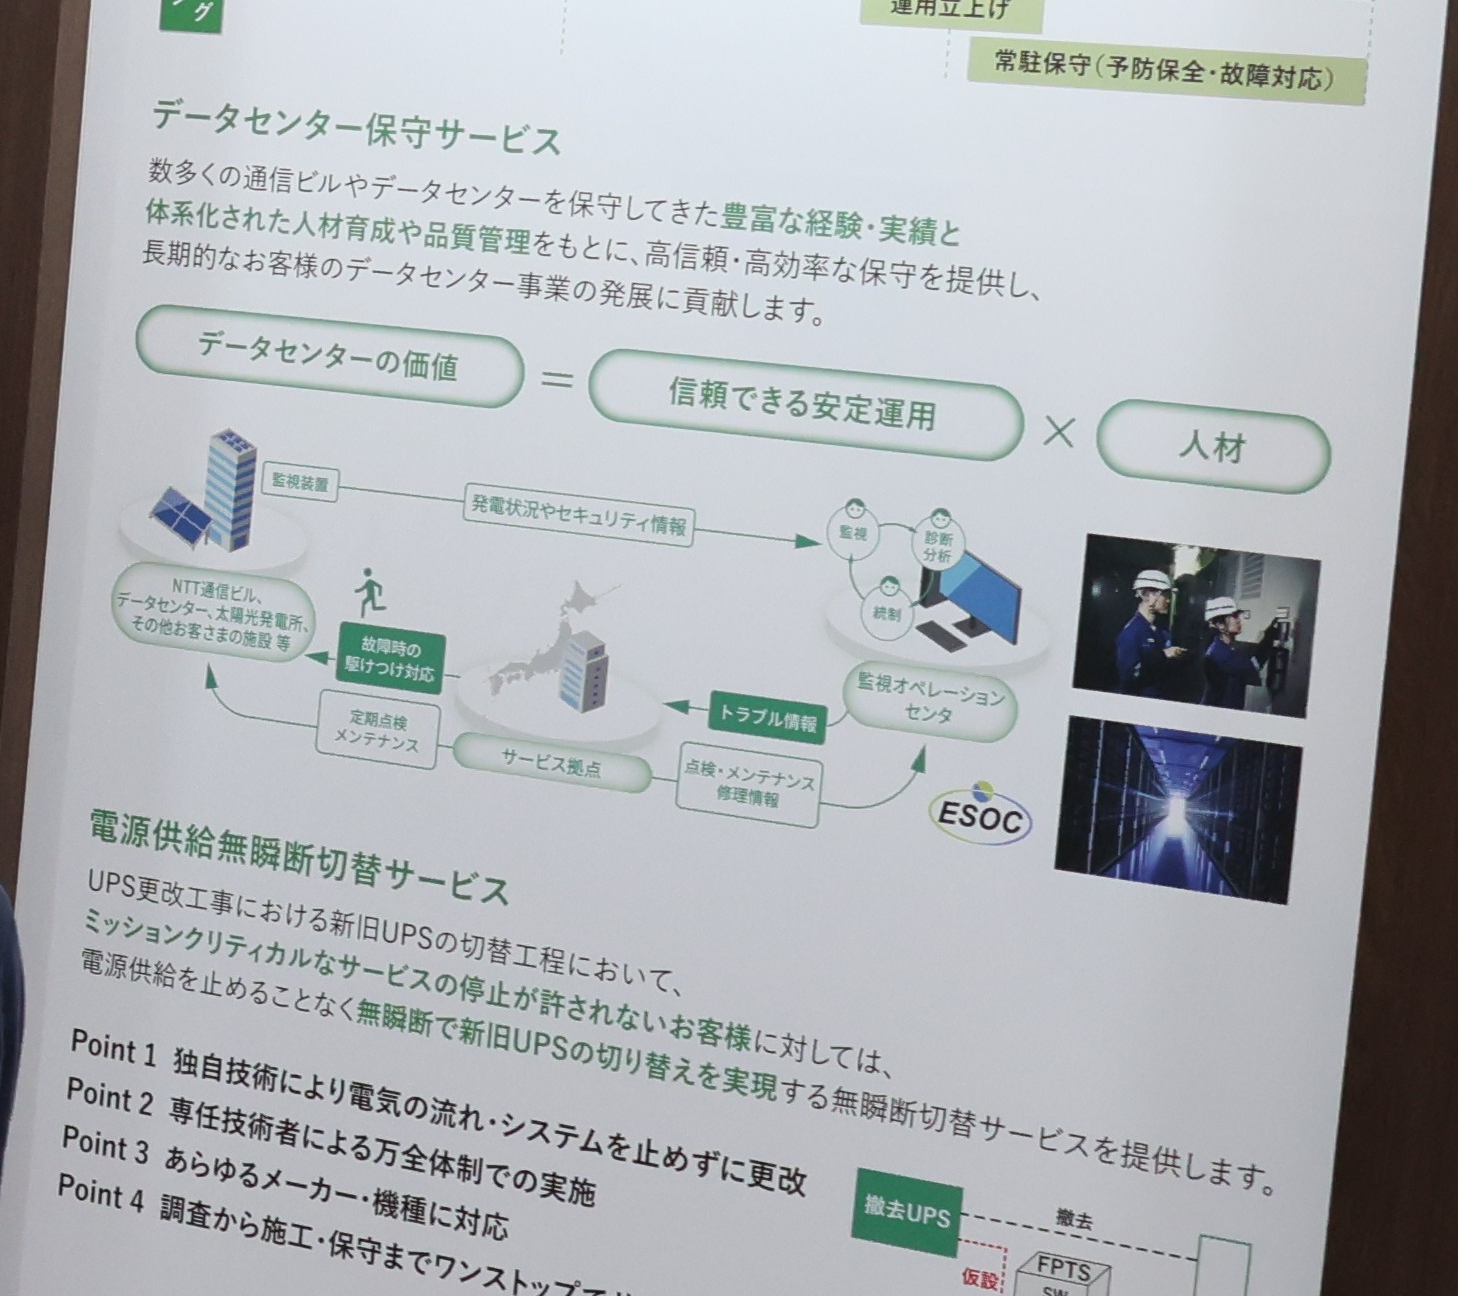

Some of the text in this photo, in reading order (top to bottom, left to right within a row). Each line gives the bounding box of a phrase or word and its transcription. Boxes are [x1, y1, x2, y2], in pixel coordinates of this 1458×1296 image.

[151, 99, 563, 159] データセンター保守サービス
[147, 156, 962, 249] 数多くの通信ビルやデータセンターを保守してきた豊富な経験・実績と
[144, 197, 1041, 303] 体系化された人材育成や品質管理をもとに、高信頼・高効率な保守を提供し、
[141, 238, 825, 328] 長期的なお客様のデータセンター事業の発展に貢献します。
[198, 329, 460, 383] データセンターの価値
[668, 374, 938, 433] 信頼できる安定運用
[1179, 428, 1248, 465] 人材
[271, 470, 330, 494] 監視装置
[471, 492, 688, 539] 発電状況やセキュリティ情報
[839, 524, 868, 542] 監視
[923, 530, 954, 547] 診断
[131, 614, 272, 650] その他お客さまの施設
[361, 634, 422, 659] 故障時の
[344, 654, 436, 684] 駆けつけ対応
[856, 670, 1006, 707] 監視オペレーション
[349, 708, 409, 732] 定期点検
[719, 704, 818, 734] トラブル情報
[904, 702, 953, 725] センタ
[333, 728, 420, 754] メンテナンス
[501, 748, 602, 779] サービス拠点
[684, 757, 816, 793] 点検・メンテナンス
[716, 784, 781, 809] 修理情報
[937, 800, 1024, 835] ESOC
[89, 806, 511, 908] 電源供給無瞬断切替サービス
[86, 868, 684, 999] UPS更改工事における新旧UPSの切替工程において、
[83, 908, 894, 1080] ミッションクリティカルなサービスの停止が許されないお客様に対しては、
[71, 1027, 808, 1199] Point 1 独自技術により電気の流れ・システムを止めずに更改
[66, 1076, 597, 1210] Point 2 専任技術者による万全体制での実施
[57, 1172, 126, 1214] Point
[128, 1186, 146, 1214] 4
[62, 1124, 510, 1244] Point 3 あらゆるメーカー・機種に対応
[864, 1192, 952, 1231] 撤去UPS
[1055, 1206, 1095, 1232] 撤去
[961, 1266, 1000, 1292] 仮設
[1036, 1255, 1093, 1283] FPTS
